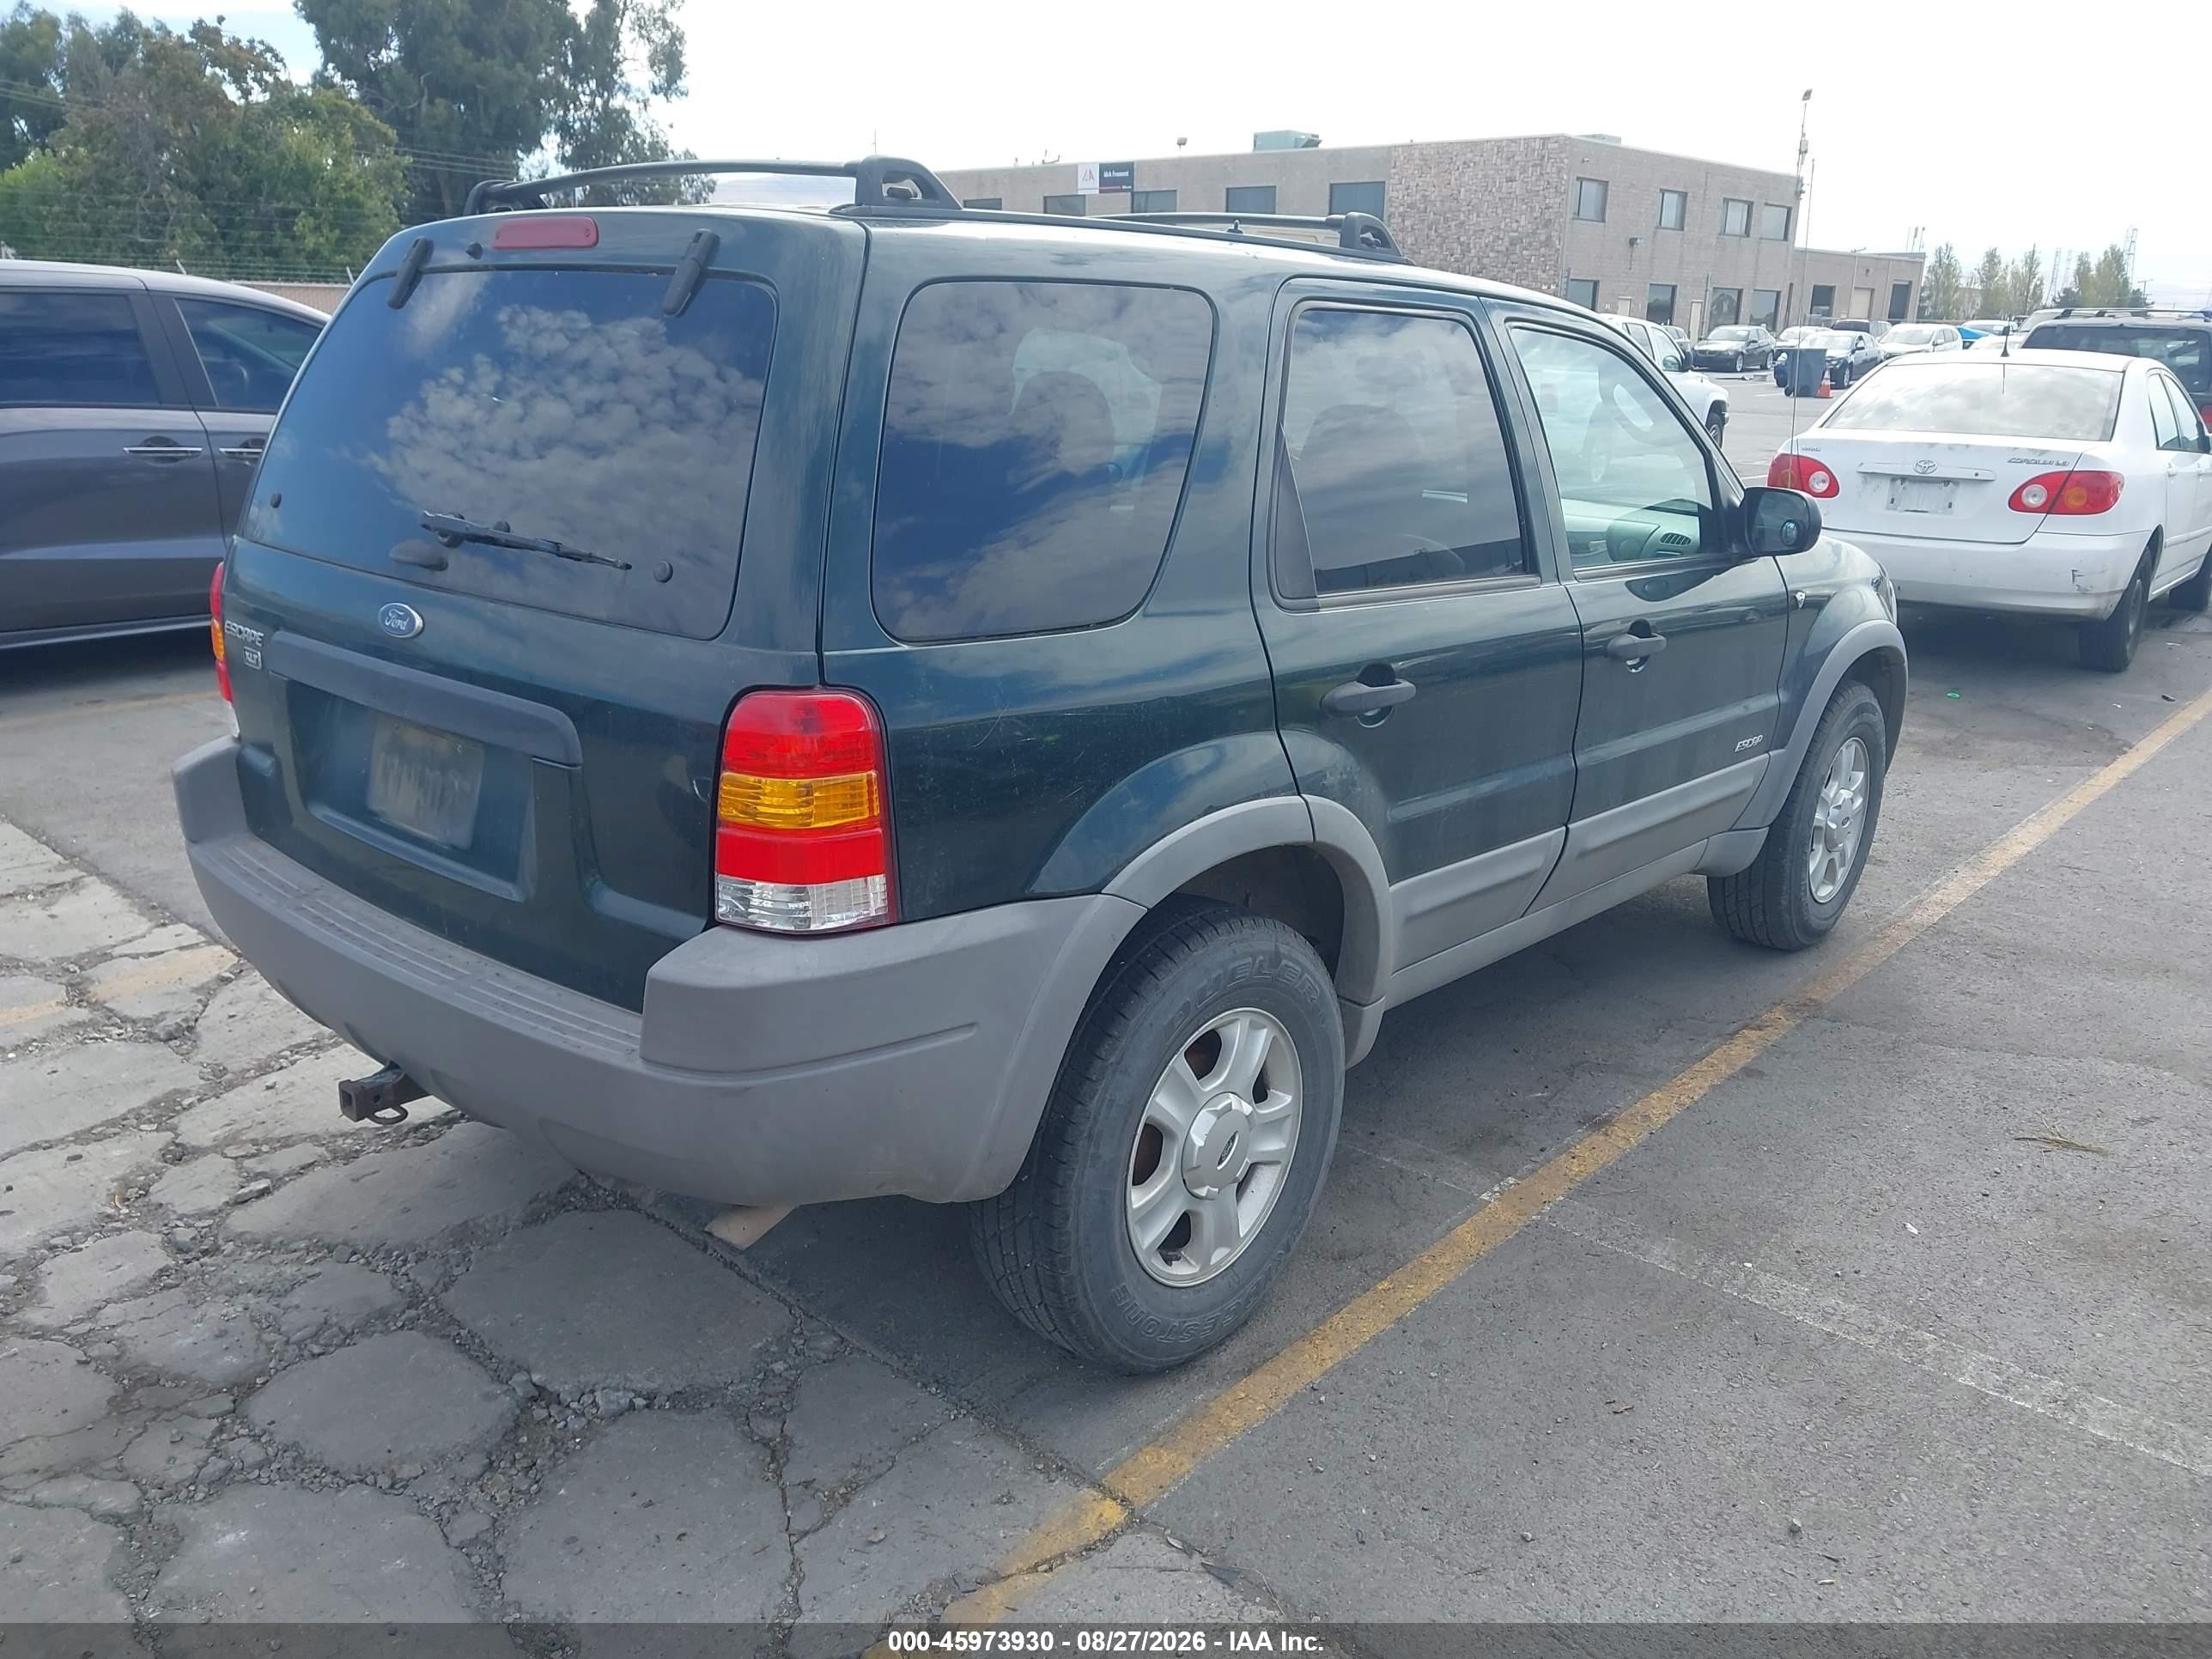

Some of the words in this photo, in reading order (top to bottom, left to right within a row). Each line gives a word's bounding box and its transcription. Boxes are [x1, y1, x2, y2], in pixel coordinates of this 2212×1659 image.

[385, 608, 409, 631] Ford
[223, 619, 264, 647] ESCAPE
[245, 650, 258, 665] XLT
